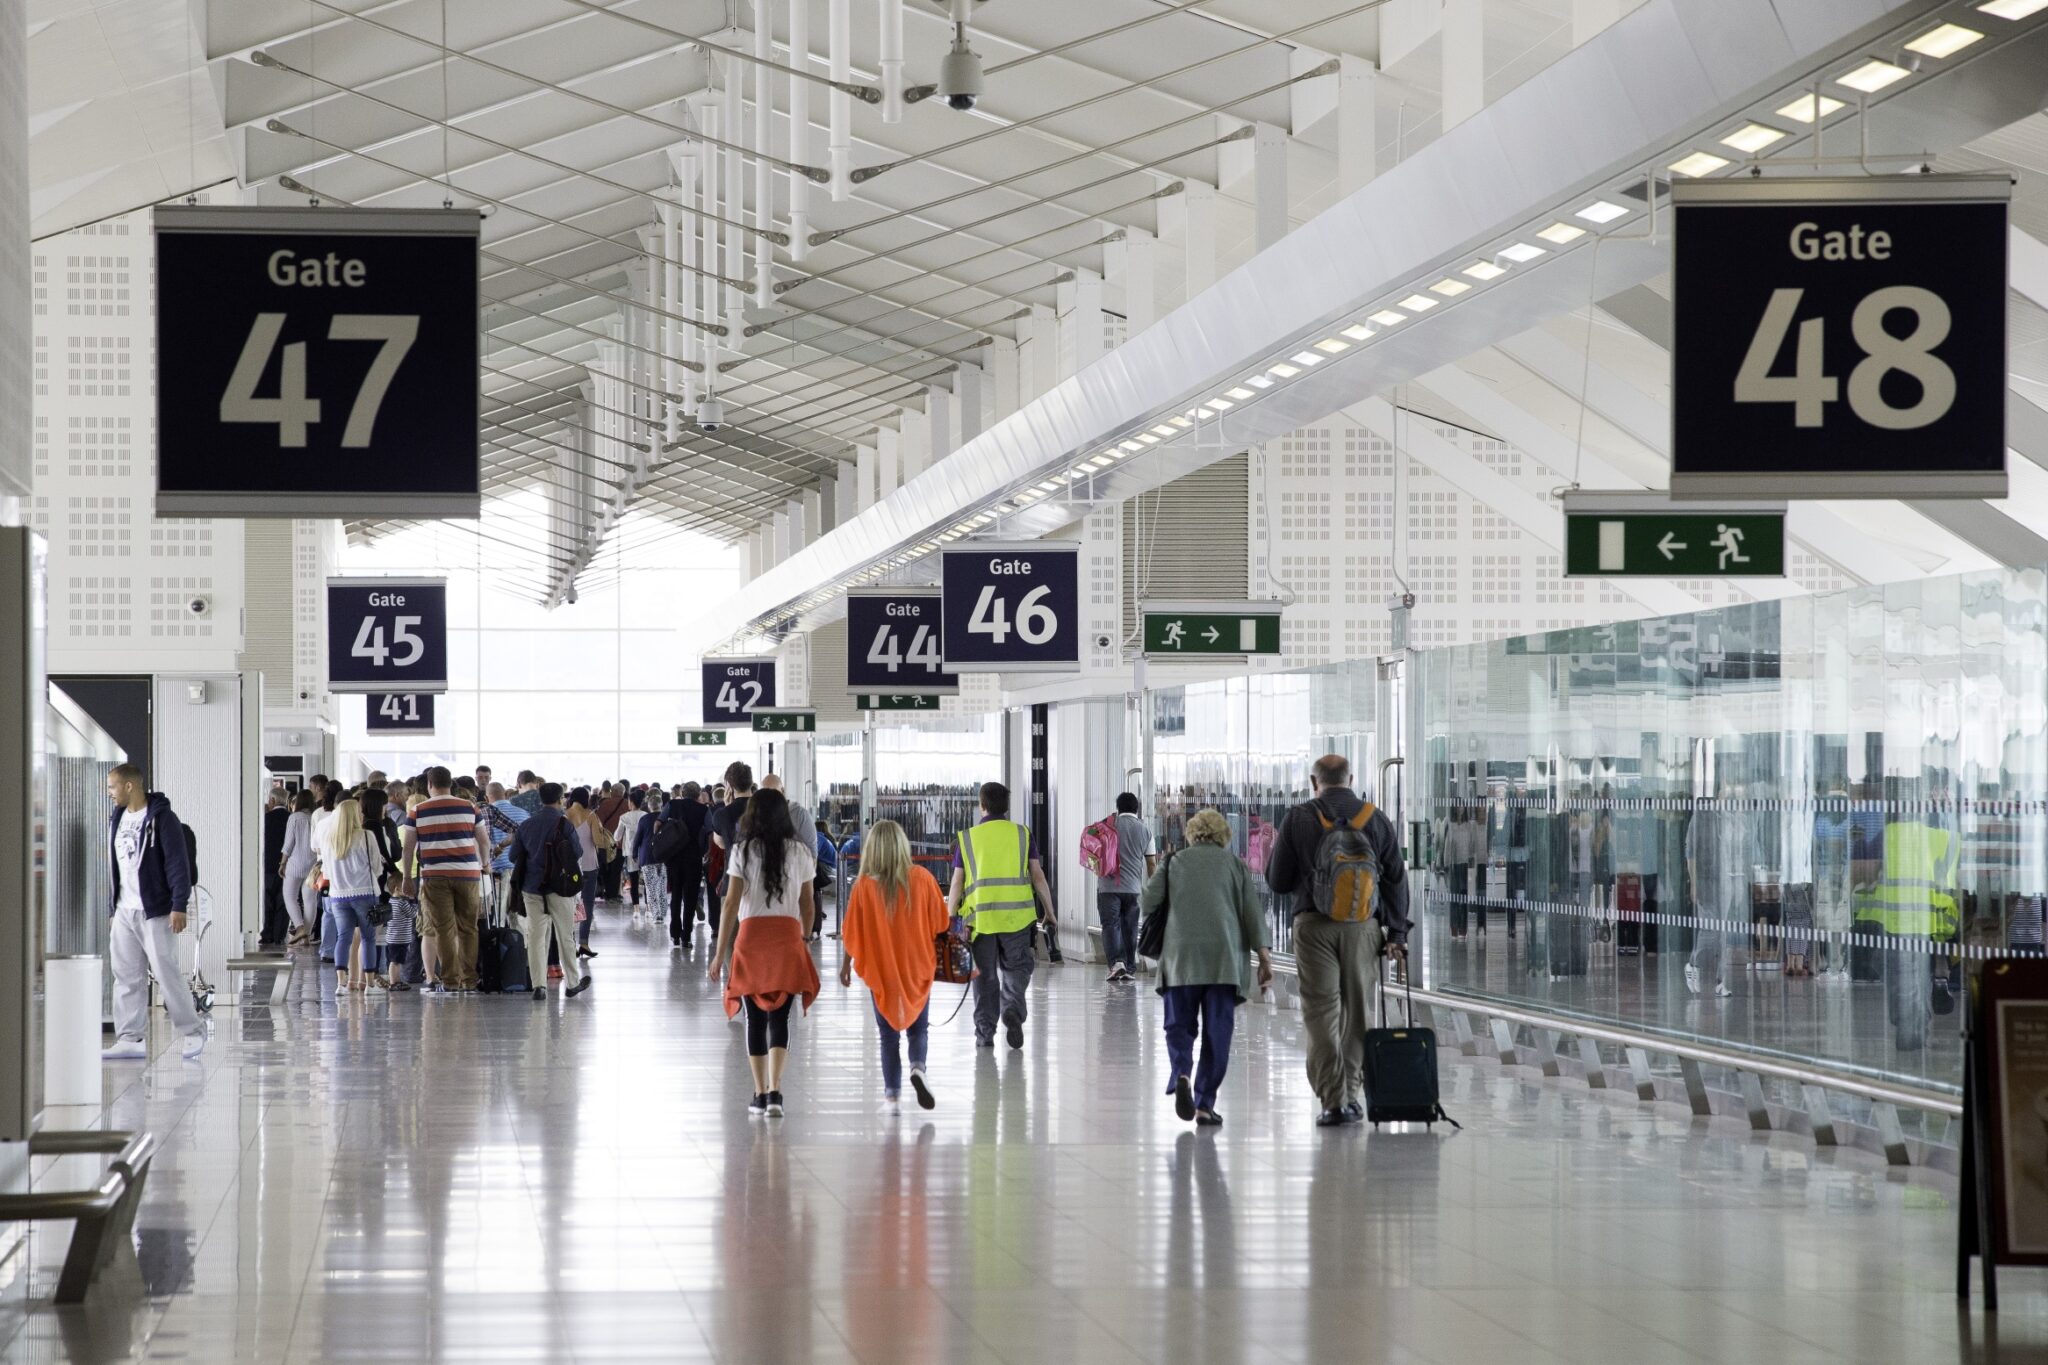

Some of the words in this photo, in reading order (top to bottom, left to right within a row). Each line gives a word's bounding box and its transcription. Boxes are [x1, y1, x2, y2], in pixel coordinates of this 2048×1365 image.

[1789, 222, 1892, 261] Gate
[268, 249, 366, 288] Gate
[1734, 286, 1957, 430] 48
[220, 313, 420, 449] 47
[989, 558, 1033, 576] Gate
[368, 592, 406, 607] Gate
[885, 602, 921, 617] Gate
[967, 584, 1058, 646] 46
[351, 615, 425, 667] 45
[866, 624, 941, 673] 44
[726, 666, 751, 676] Gate
[379, 694, 421, 721] 41
[715, 680, 763, 713] 42
